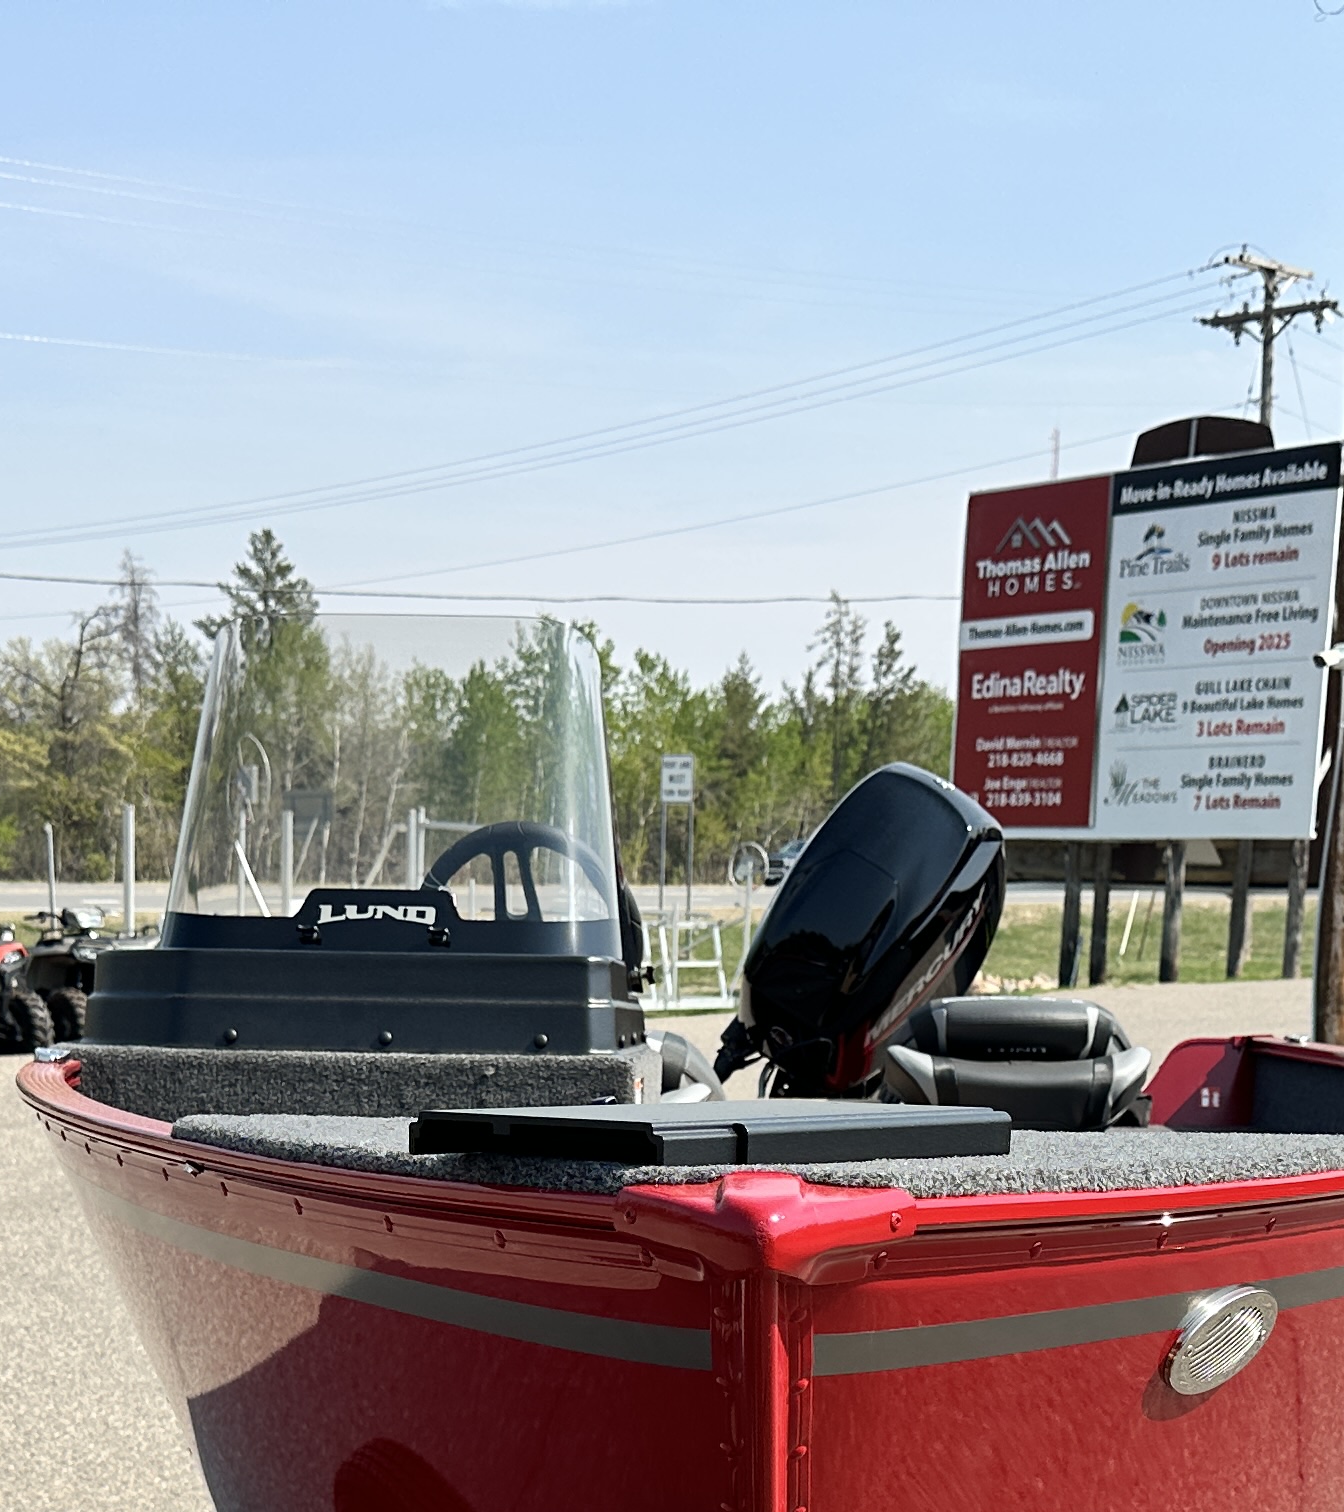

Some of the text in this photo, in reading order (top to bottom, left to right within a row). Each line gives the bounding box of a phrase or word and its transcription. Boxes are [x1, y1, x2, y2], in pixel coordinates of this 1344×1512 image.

[1120, 459, 1328, 506] Move-in-Ready Homes Available
[1197, 522, 1313, 549] Single Family Homes
[976, 549, 1091, 579] Thomas Allen
[1119, 552, 1190, 578] Pine Trails
[1212, 545, 1299, 571] 9 Lots remain
[987, 571, 1073, 598] HOMES
[1181, 606, 1319, 630] Maintenance Free Living
[1203, 634, 1256, 657] Opening
[1195, 676, 1291, 695] GULL LAKE CHAIN
[1130, 706, 1176, 724] LAKE
[1189, 697, 1237, 714] Beautiful
[1239, 697, 1264, 711] Lake
[1266, 696, 1304, 710] Homes
[1196, 720, 1205, 737] 3
[1206, 719, 1233, 737] Lots
[1235, 716, 1285, 735] Remain
[1208, 754, 1266, 770] BRAINERD
[1180, 773, 1294, 791] Single Family Homes
[1194, 791, 1281, 811] 7 Lots Remain
[317, 904, 436, 925] LUND
